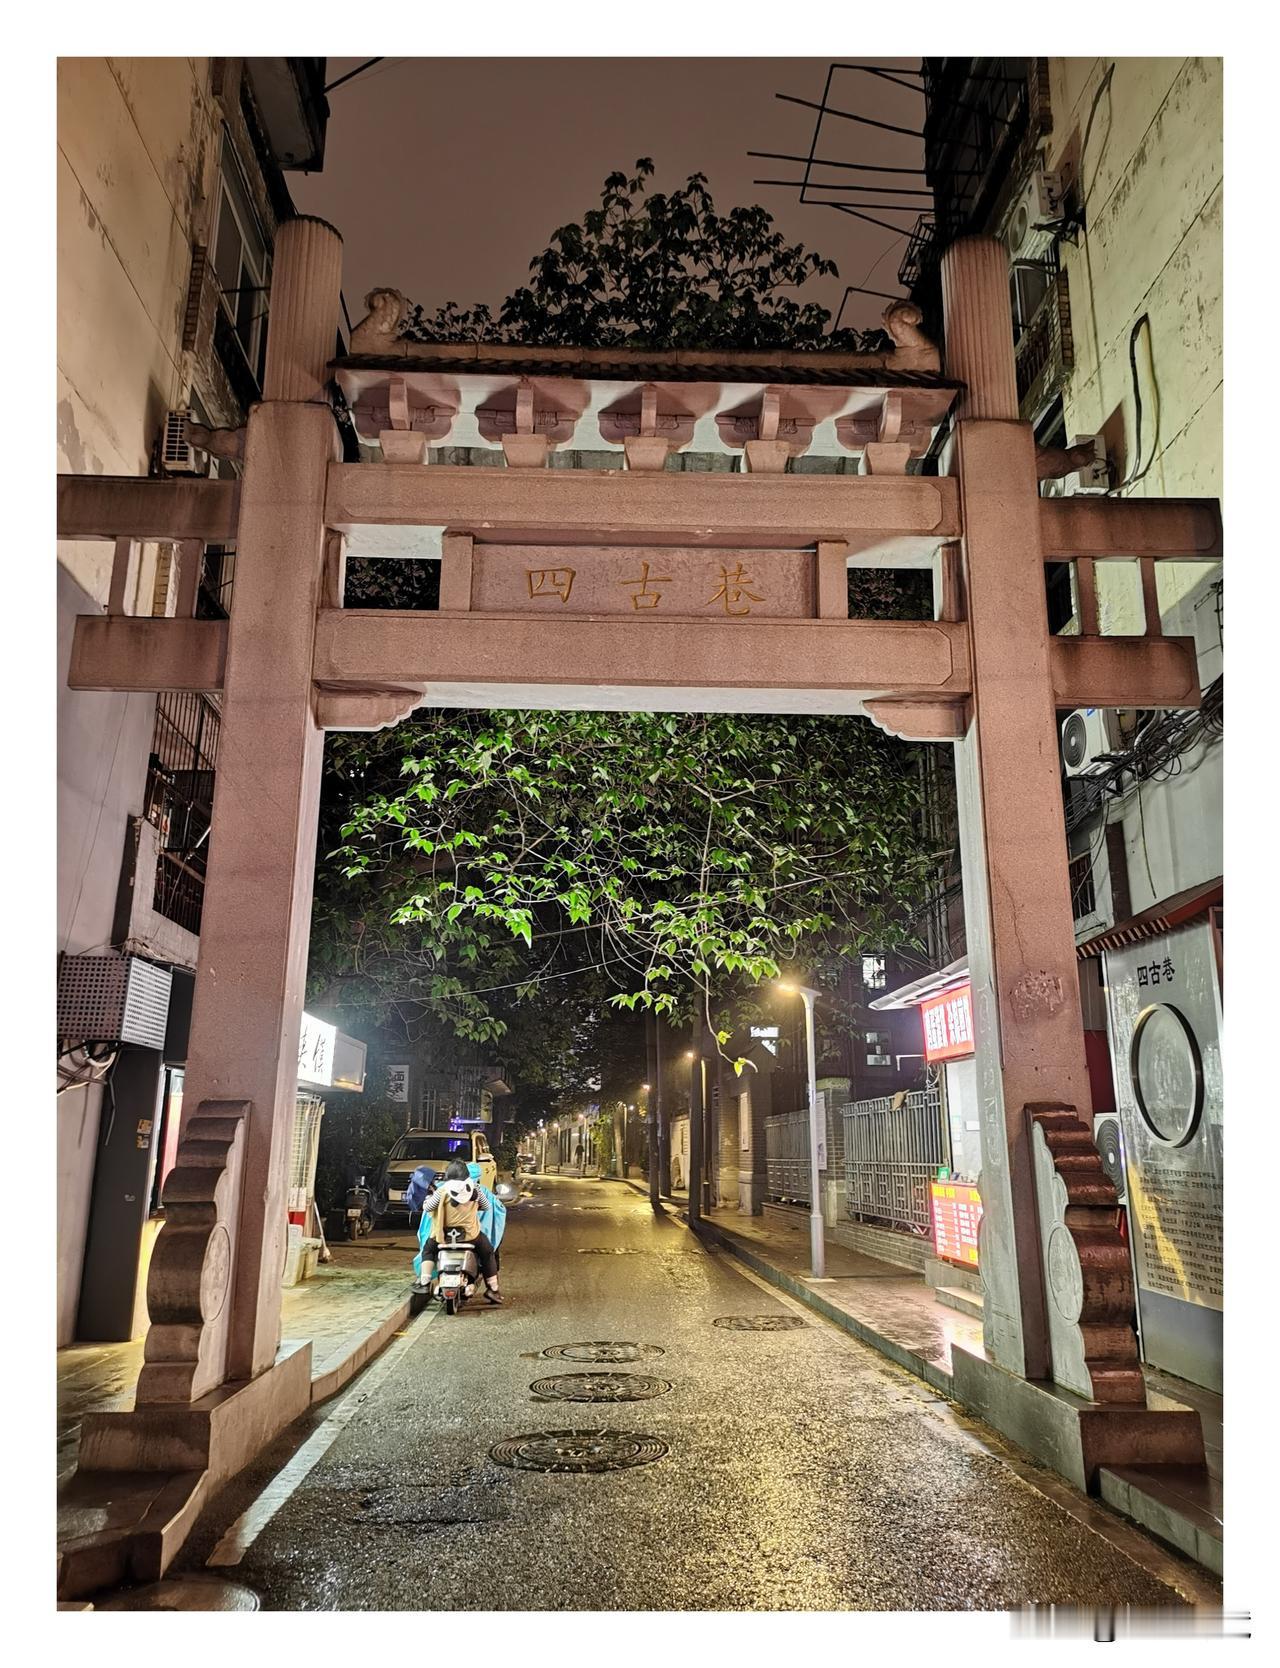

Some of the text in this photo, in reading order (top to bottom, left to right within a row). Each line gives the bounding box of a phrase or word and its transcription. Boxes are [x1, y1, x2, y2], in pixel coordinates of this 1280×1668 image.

[525, 560, 766, 616] 四古巷
[1137, 956, 1175, 987] 四古巷
